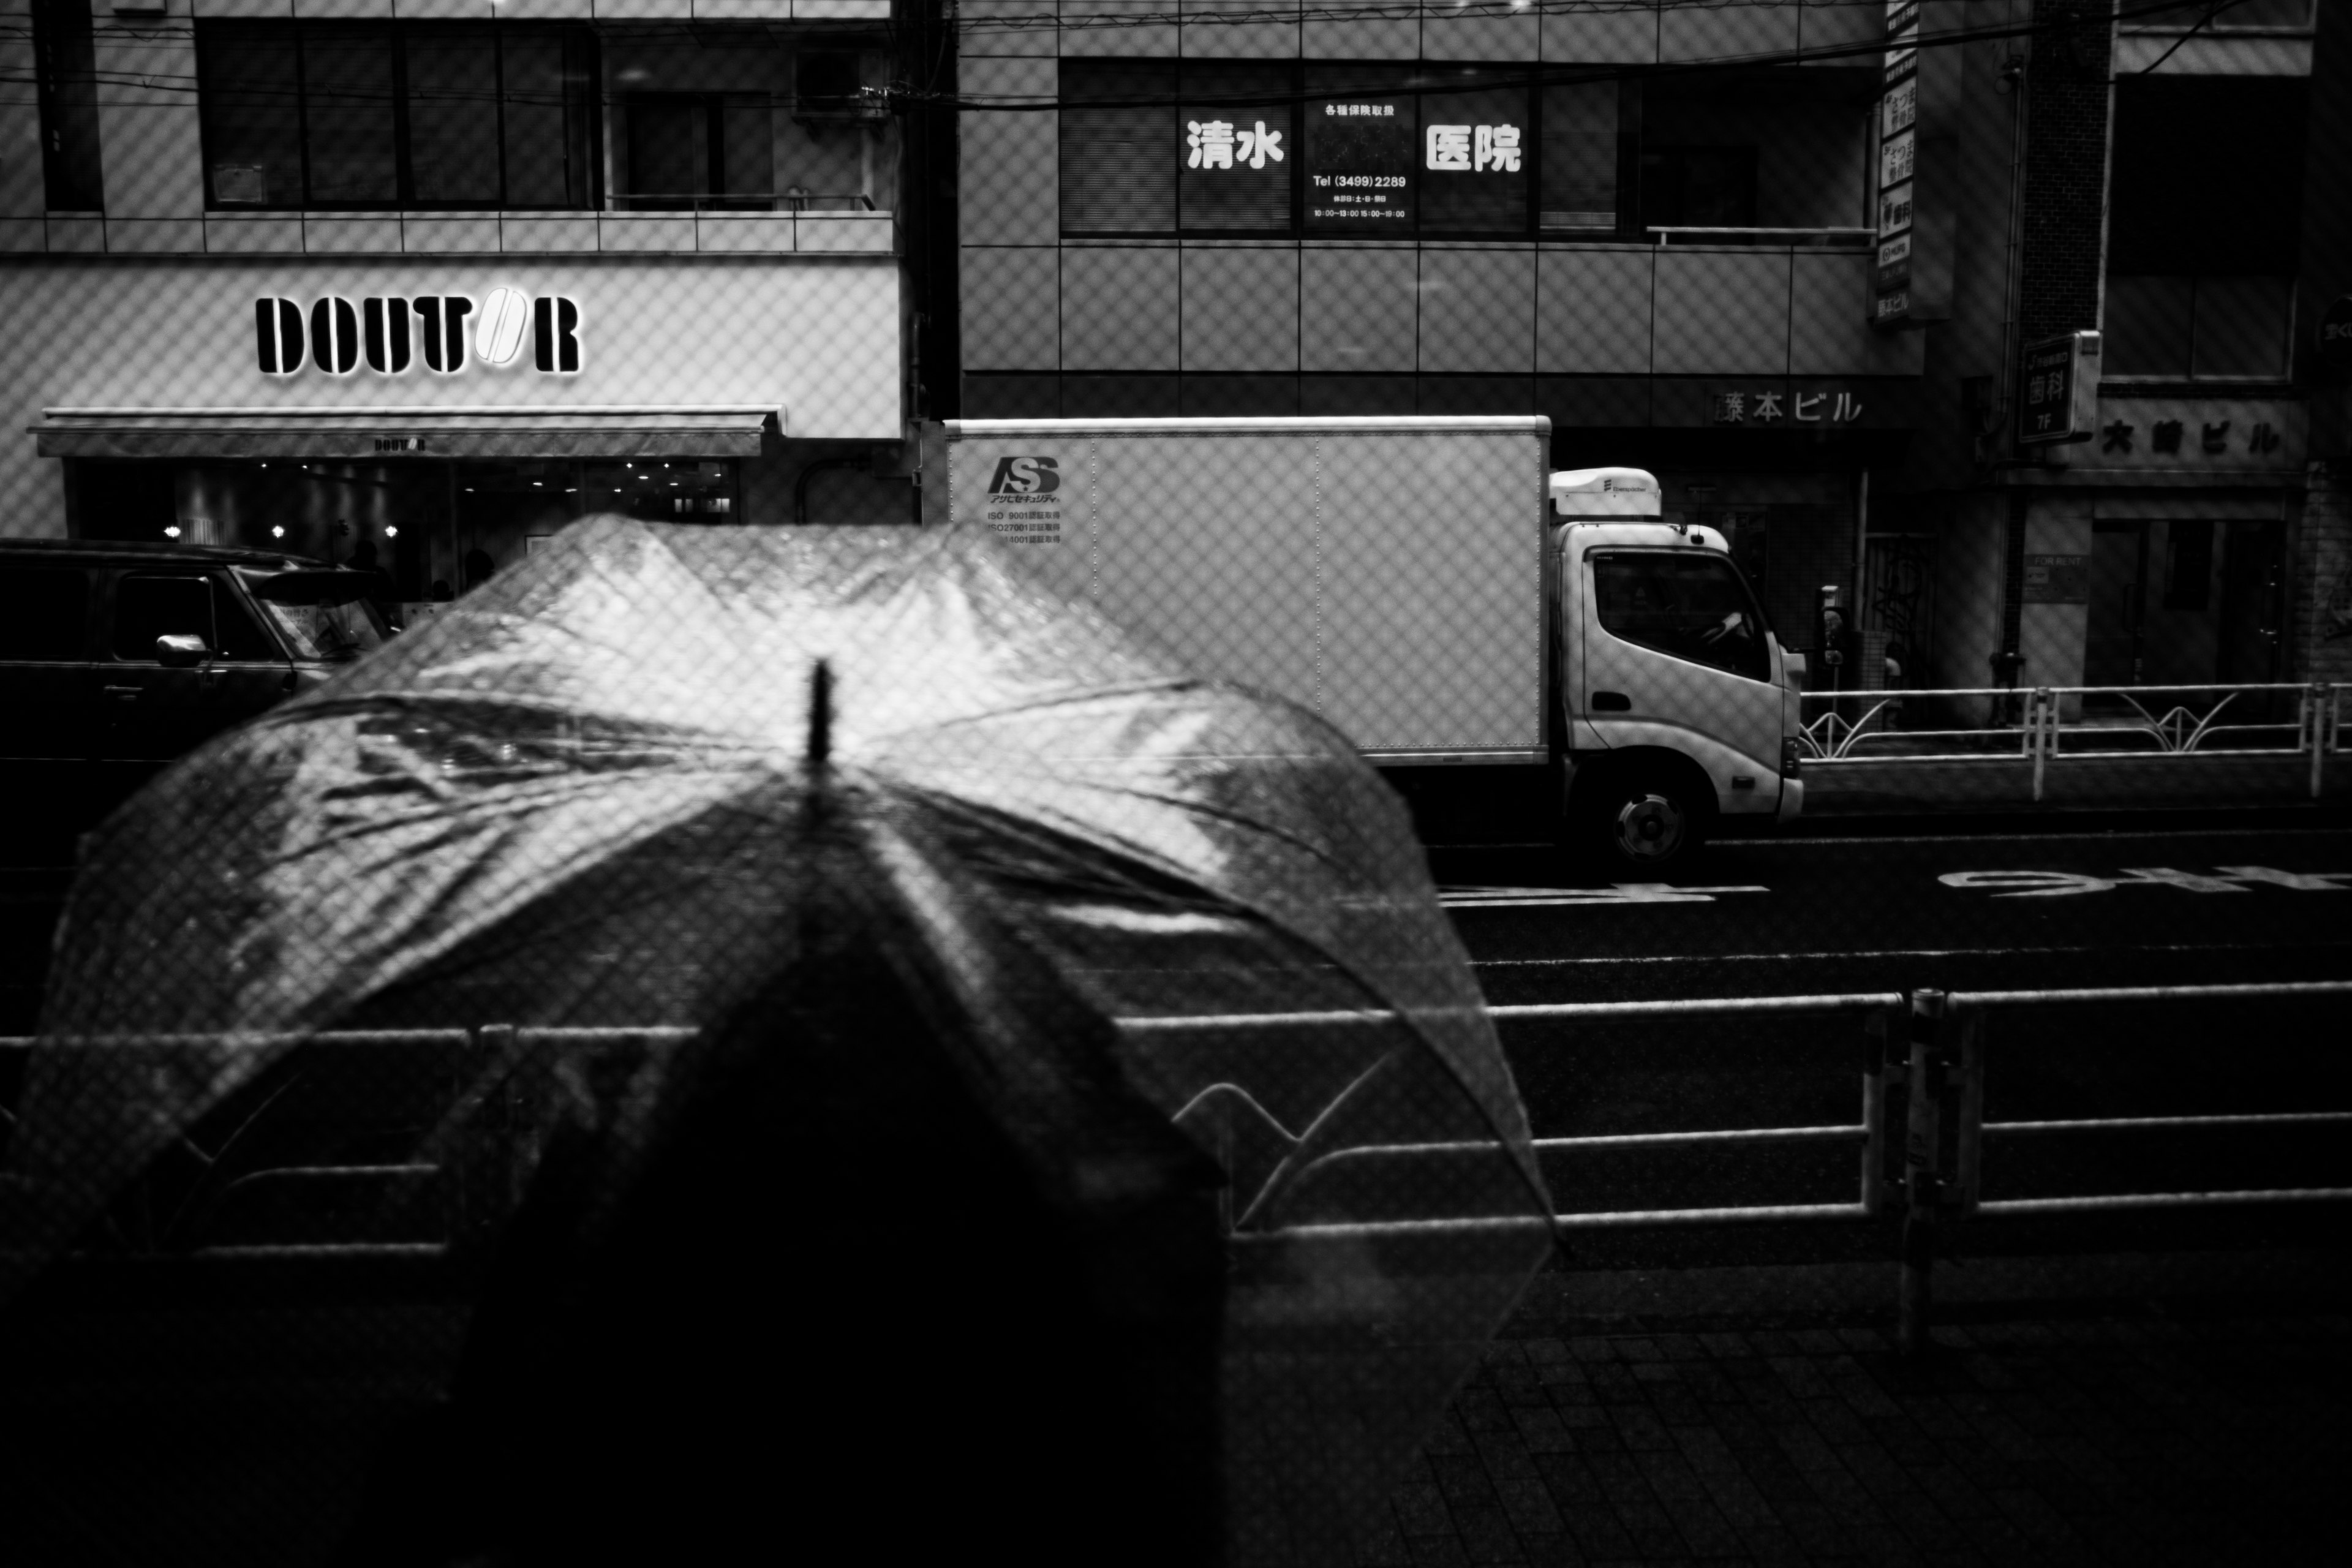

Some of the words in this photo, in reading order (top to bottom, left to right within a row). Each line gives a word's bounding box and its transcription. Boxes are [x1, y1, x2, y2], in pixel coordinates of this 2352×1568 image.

[1325, 104, 1394, 116] 各種保険取扱
[1187, 120, 1284, 169] 清水
[1427, 124, 1521, 172] 医院
[1313, 175, 1331, 186] Tel
[255, 287, 579, 374] DOUTOR
[2029, 369, 2065, 405] 歯科
[1714, 391, 1863, 421] 藤本ビル
[2037, 412, 2052, 430] 7F
[375, 438, 426, 451] DOUTOR
[2035, 557, 2054, 565] FOR
[2056, 557, 2082, 565] RENT
